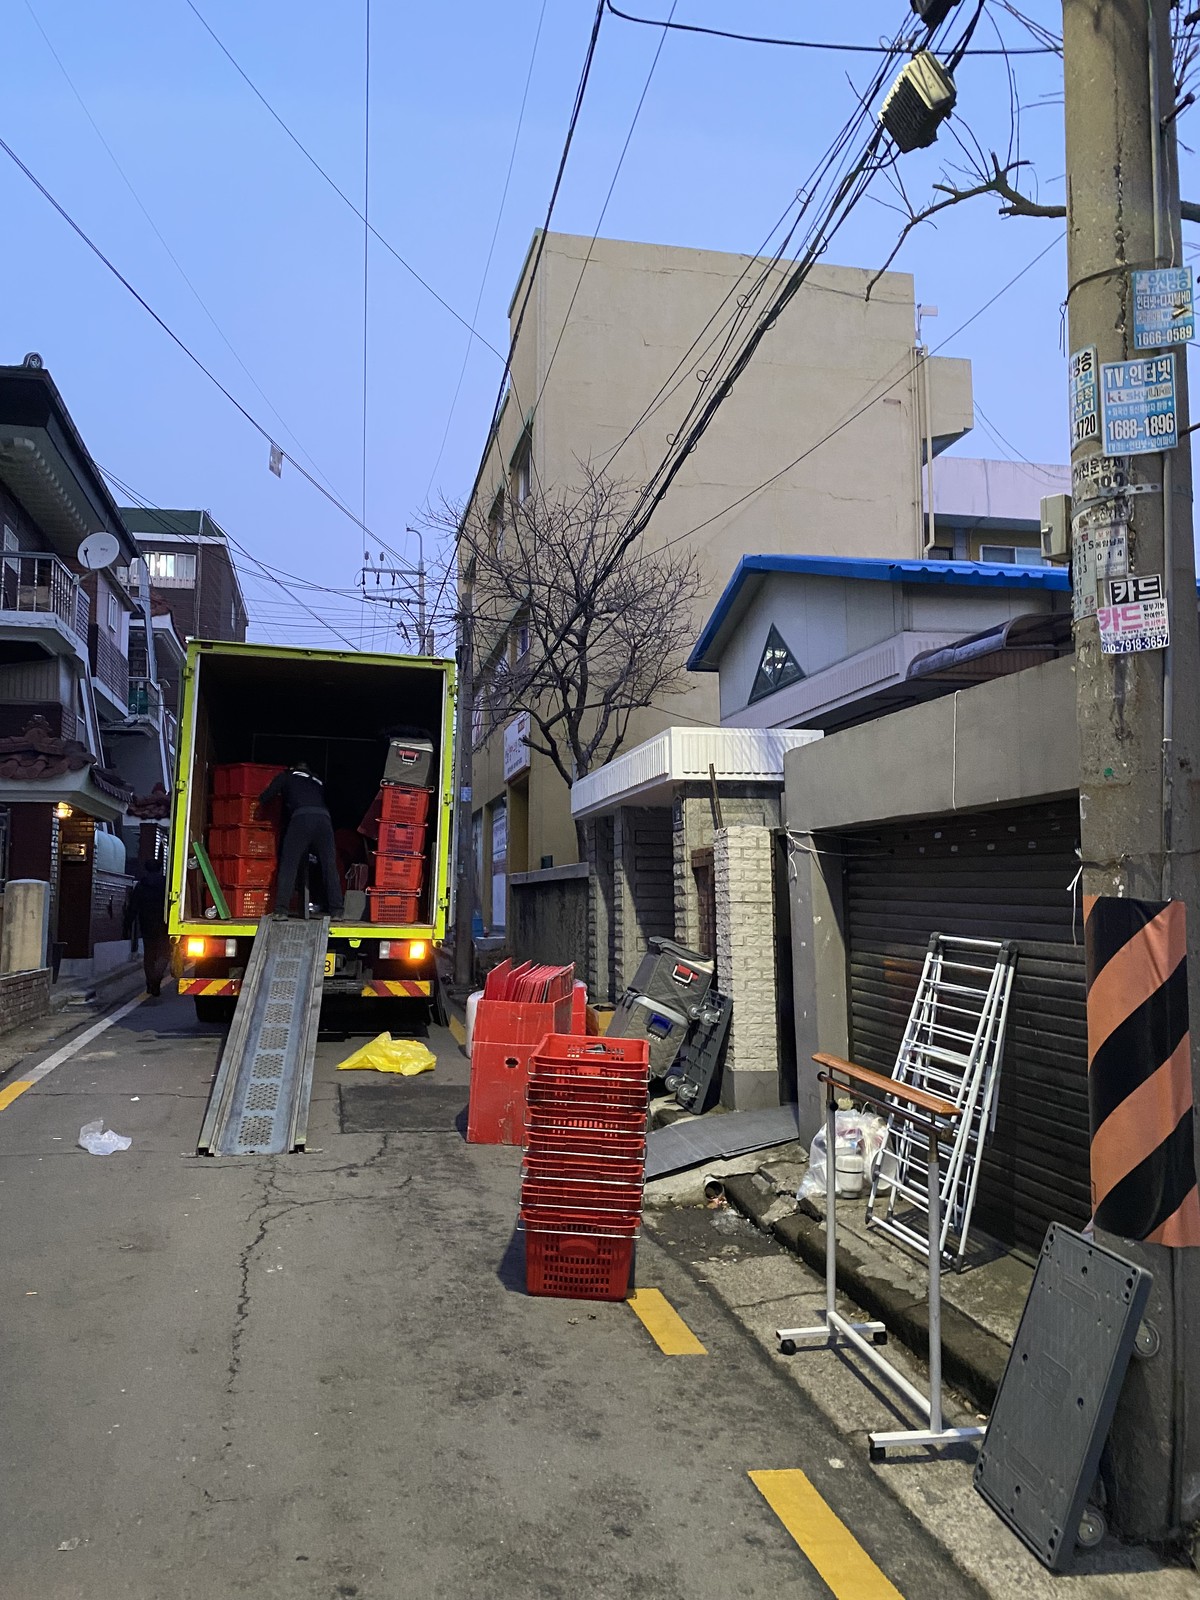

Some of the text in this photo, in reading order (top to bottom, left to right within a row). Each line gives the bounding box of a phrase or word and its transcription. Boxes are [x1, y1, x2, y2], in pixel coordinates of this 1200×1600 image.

[1137, 325, 1192, 346] 1666-0589
[1108, 412, 1174, 441] 1688-1896
[1113, 577, 1160, 603] 카드
[1098, 604, 1143, 632] 카드
